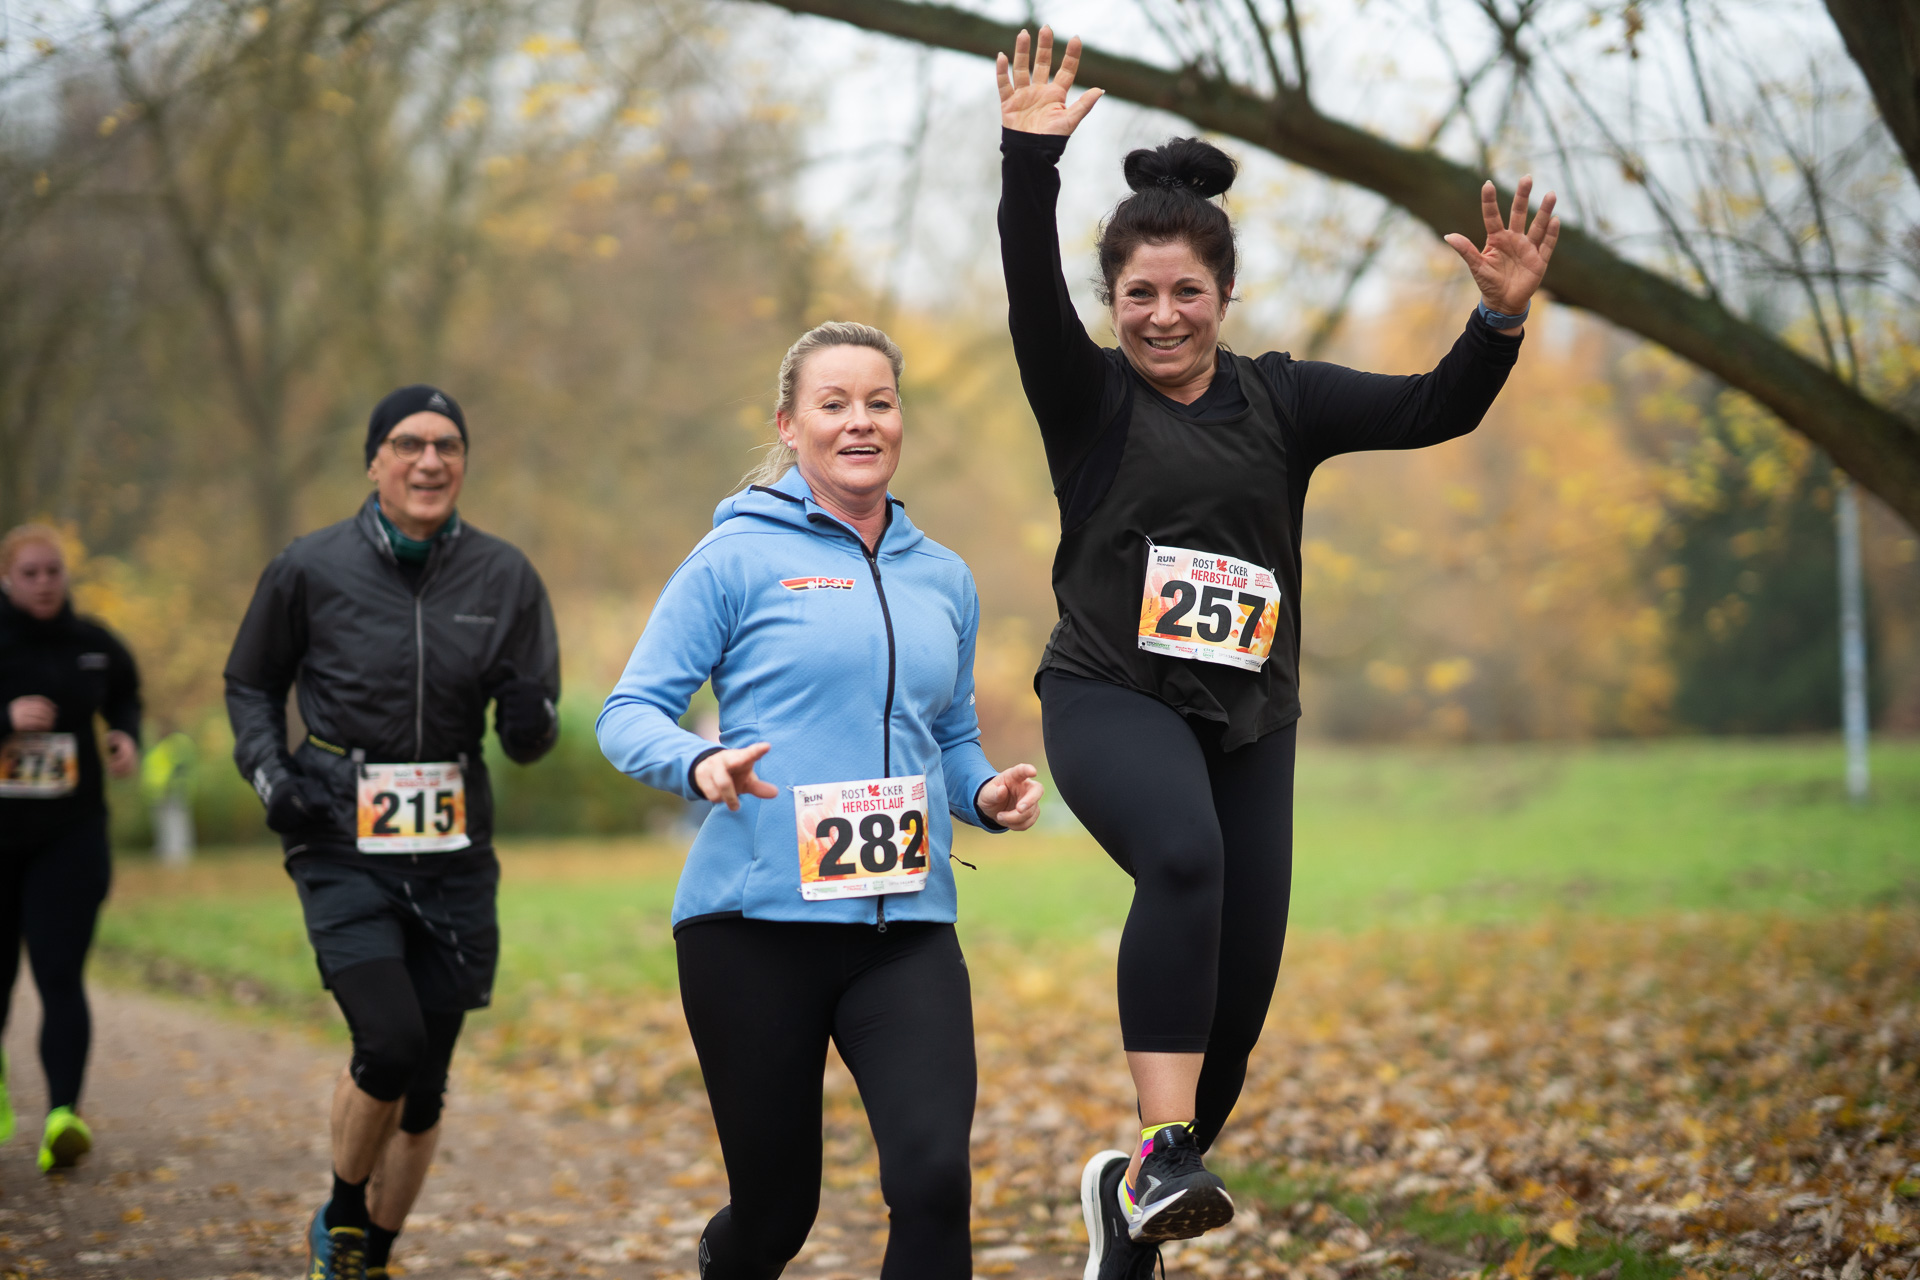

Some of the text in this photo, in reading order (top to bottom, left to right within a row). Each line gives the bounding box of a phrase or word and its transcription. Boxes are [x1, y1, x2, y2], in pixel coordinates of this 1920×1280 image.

[1156, 555, 1176, 563] RUN
[1190, 569, 1248, 589] HERBSTLAUF
[1154, 579, 1267, 649] 257
[804, 793, 823, 803] RUN
[842, 796, 905, 813] HERBSTLAUF
[372, 790, 455, 834] 215
[815, 809, 927, 877] 282
